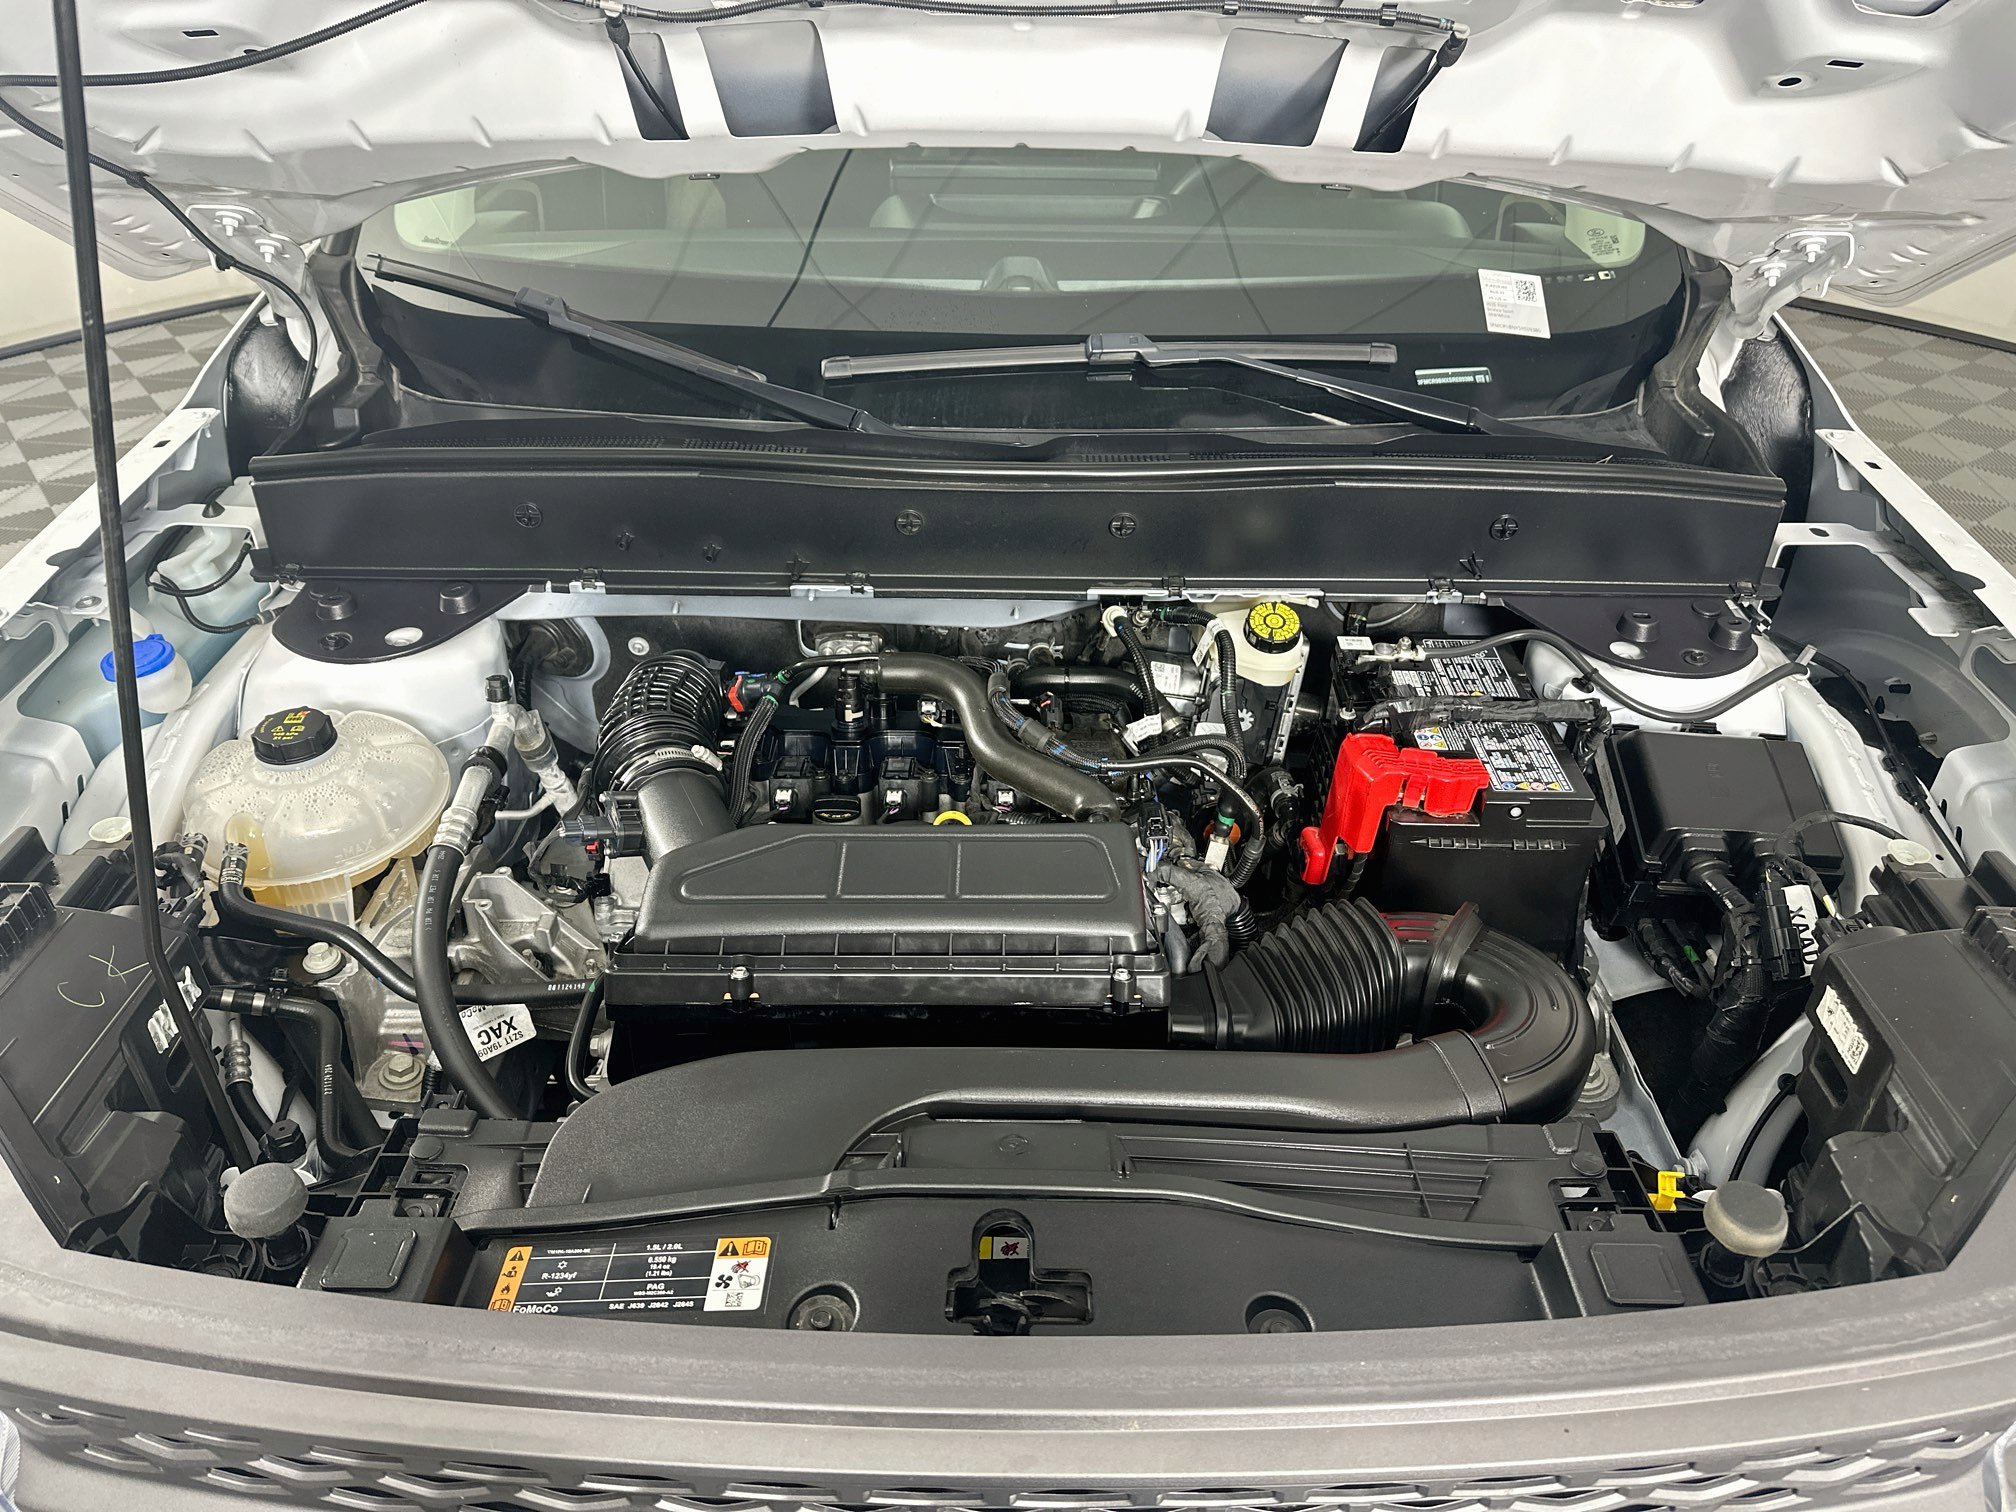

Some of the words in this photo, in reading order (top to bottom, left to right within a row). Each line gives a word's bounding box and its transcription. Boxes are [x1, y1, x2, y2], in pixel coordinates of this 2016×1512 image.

[477, 1015, 518, 1046] XAC
[504, 1030, 524, 1046] SZ1T
[666, 1255, 677, 1264] kg
[541, 1271, 578, 1281] R-1234yf
[646, 1282, 666, 1291] PAG
[512, 1304, 559, 1314] FoMoCo
